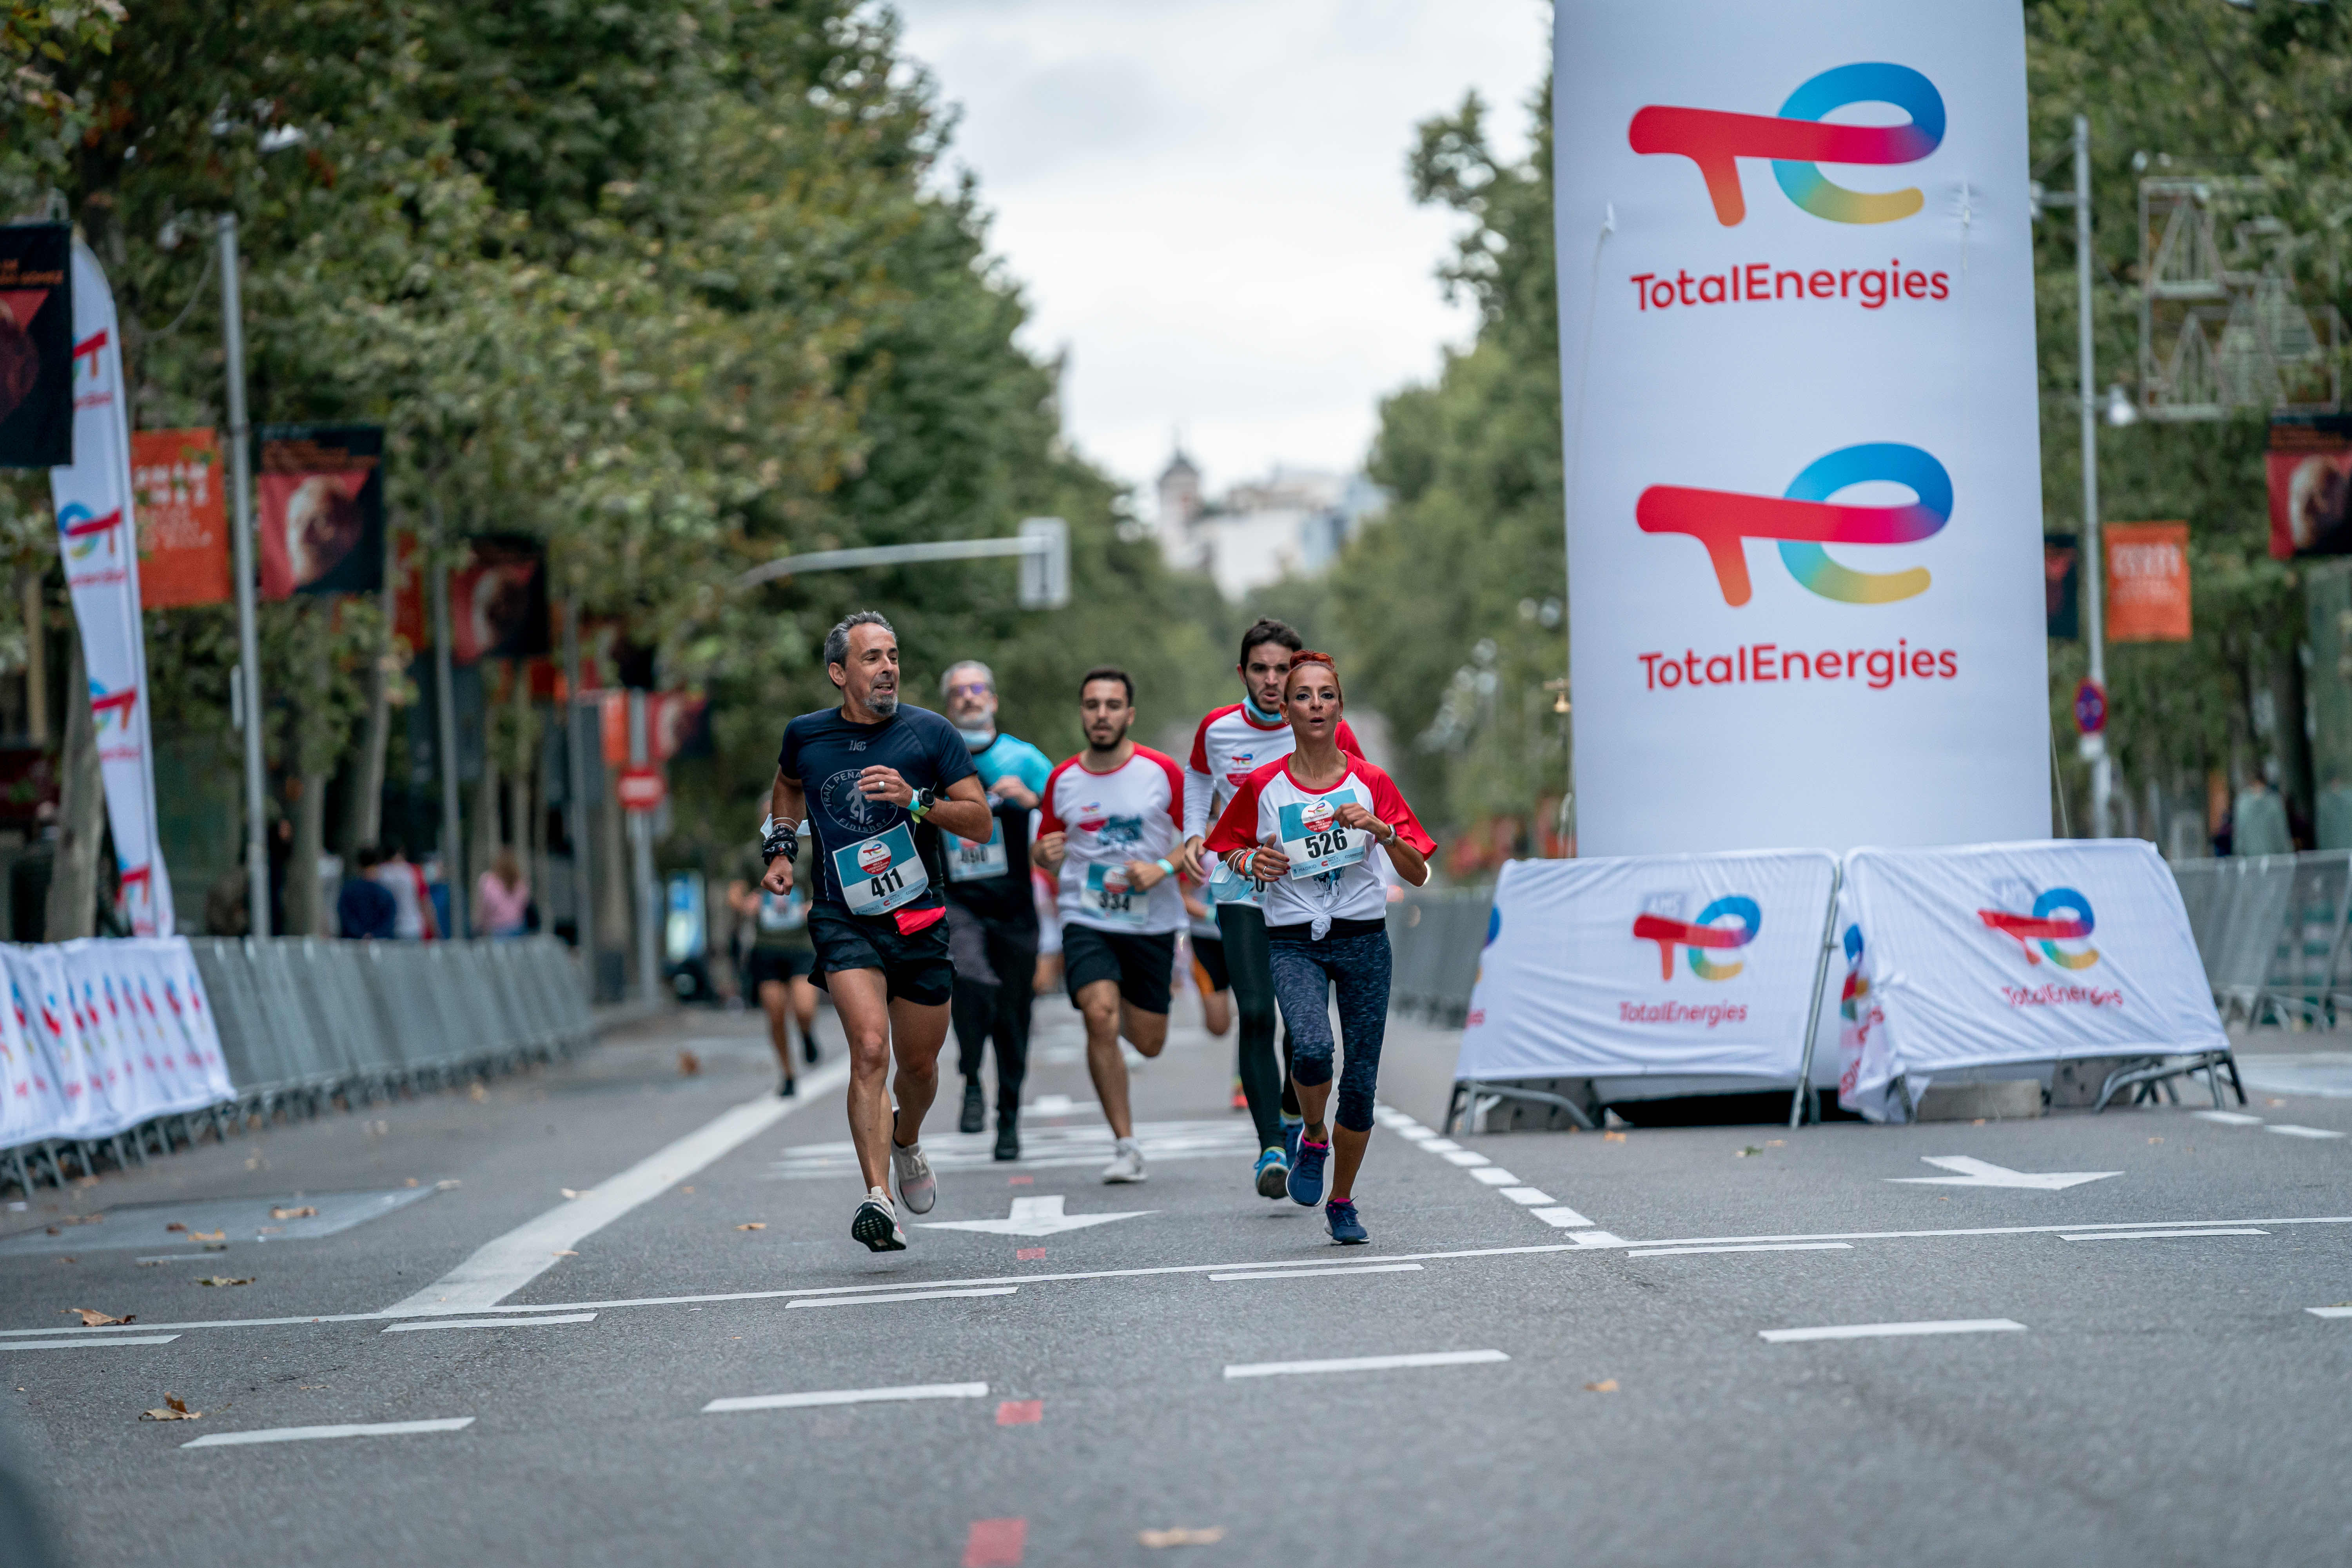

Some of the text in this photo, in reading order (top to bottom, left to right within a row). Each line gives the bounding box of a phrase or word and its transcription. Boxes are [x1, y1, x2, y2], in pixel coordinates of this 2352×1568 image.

[1630, 258, 1950, 311] TotalEnergies
[1638, 637, 1958, 691] TotalEnergies
[823, 769, 865, 807] TRAIL PEÑA
[838, 818, 887, 833] Finisher
[1305, 829, 1347, 858] 526
[871, 867, 904, 898] 411
[862, 906, 880, 914] MADRID
[1619, 998, 1748, 1029] TotalEnergies
